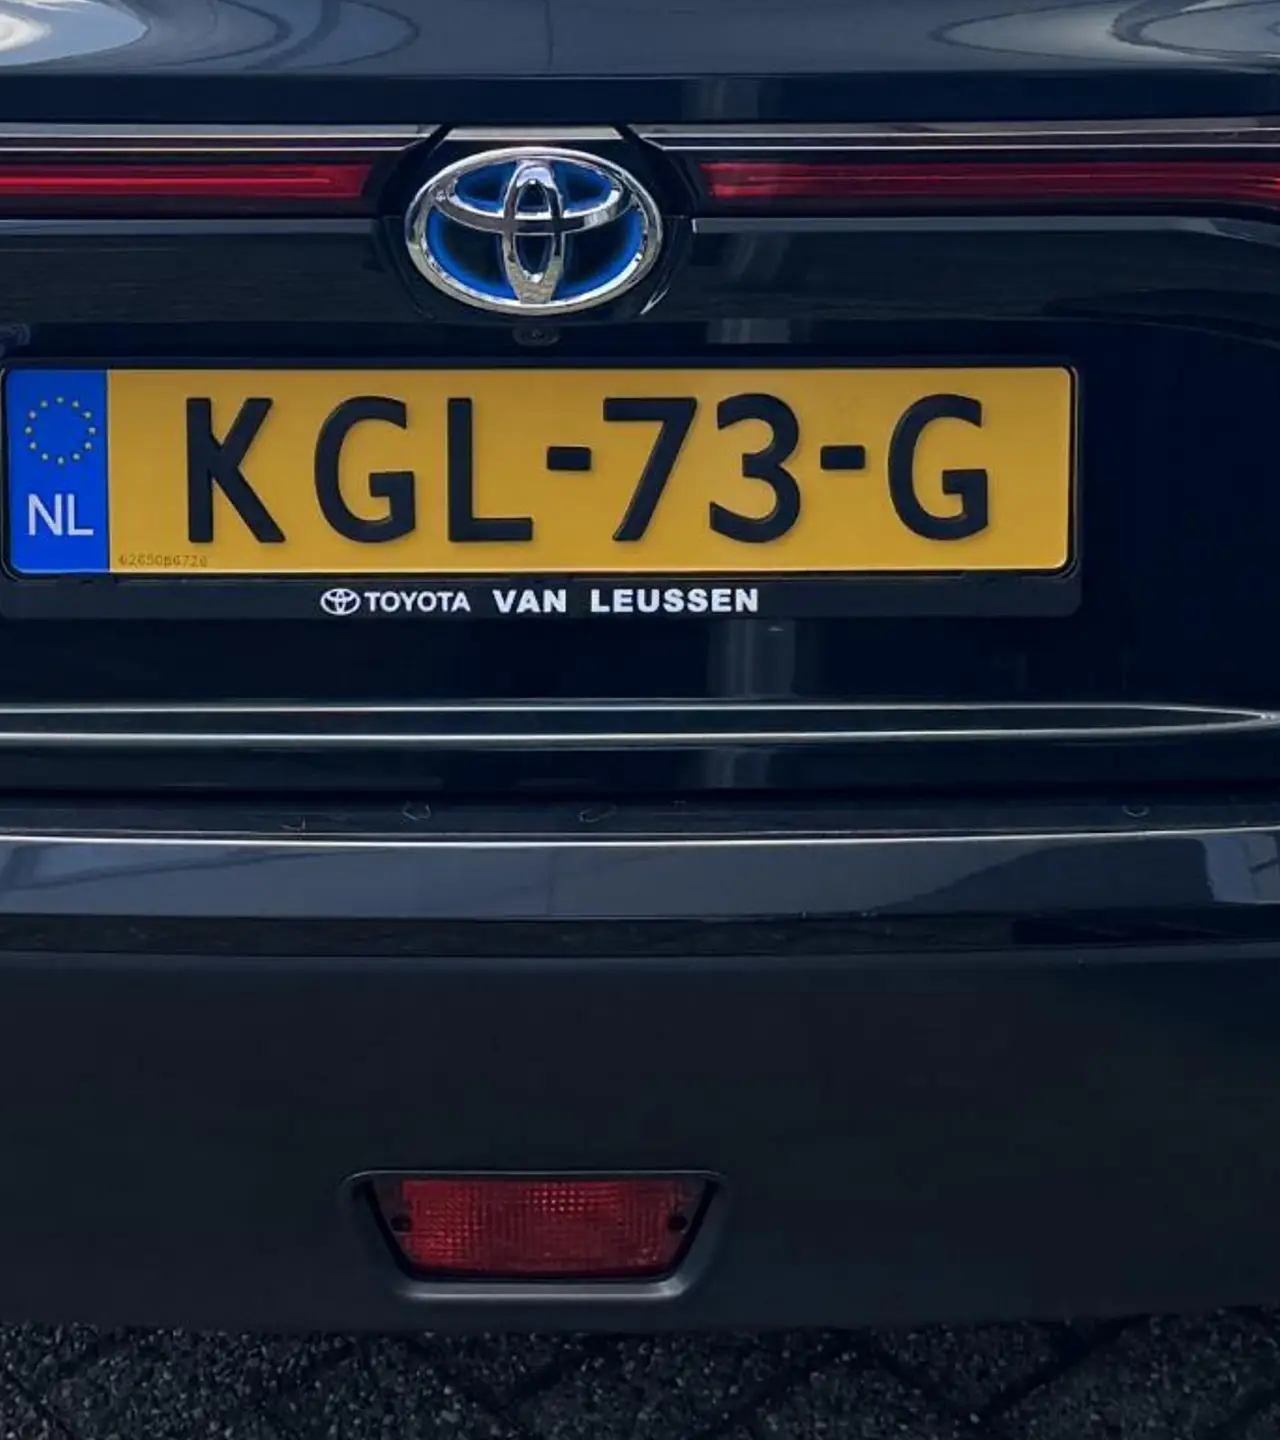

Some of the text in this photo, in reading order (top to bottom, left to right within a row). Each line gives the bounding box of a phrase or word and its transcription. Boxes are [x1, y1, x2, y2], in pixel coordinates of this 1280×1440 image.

[186, 393, 990, 543] KGL-73-G
[28, 493, 94, 536] NL
[364, 587, 759, 613] TOYOTA VAN LEUSSEN
